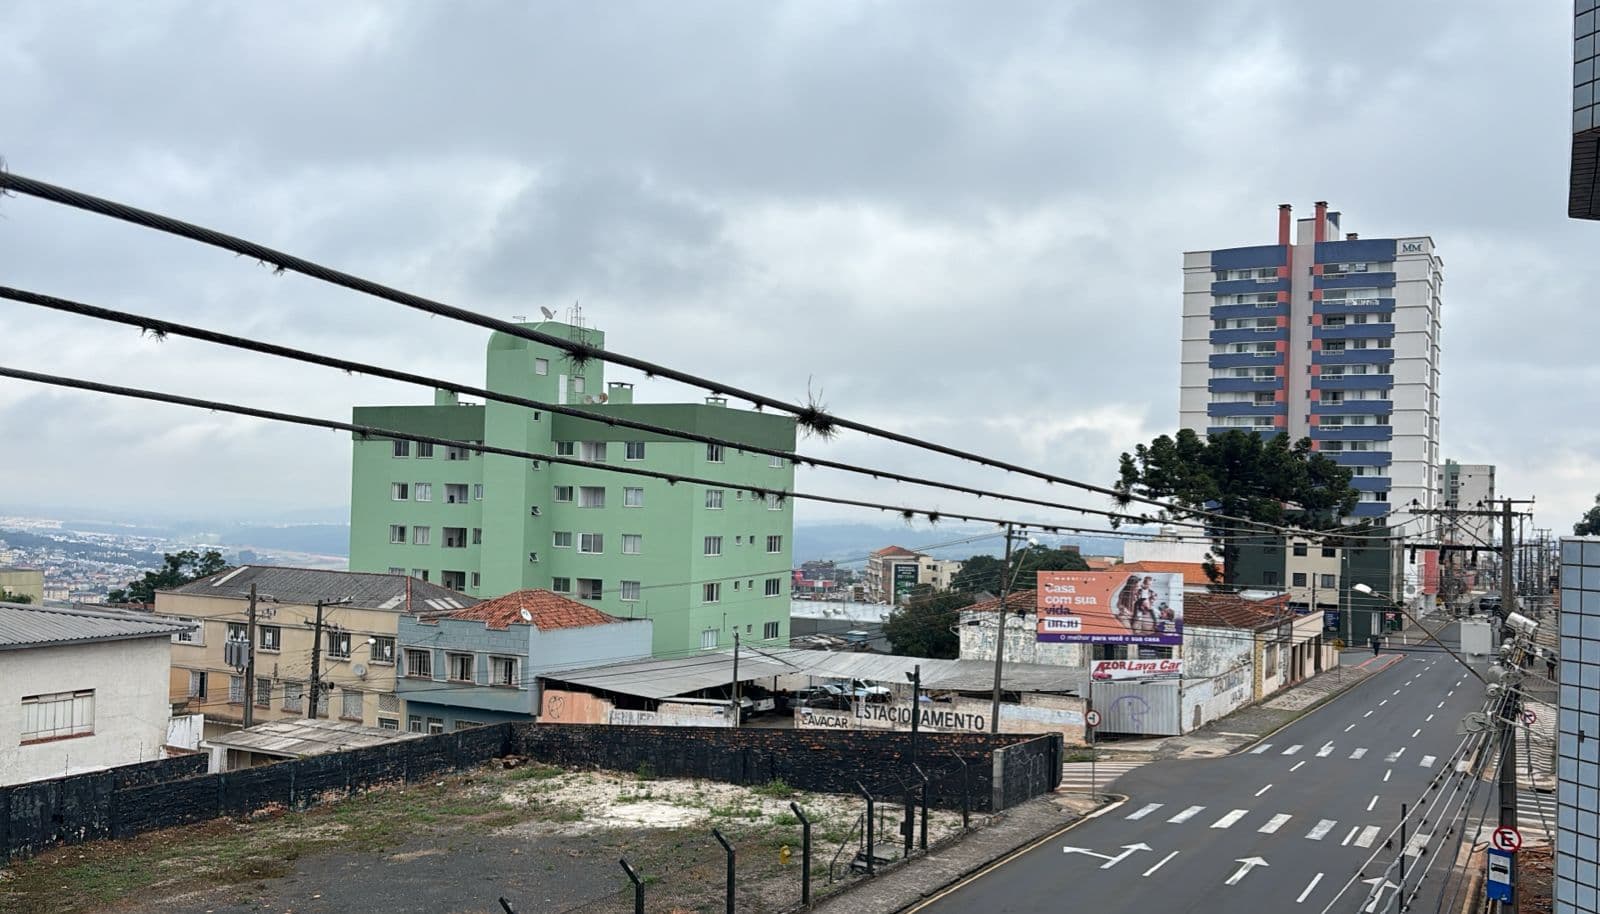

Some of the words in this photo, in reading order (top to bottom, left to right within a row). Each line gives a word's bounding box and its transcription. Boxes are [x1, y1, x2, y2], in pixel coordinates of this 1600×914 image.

[1045, 583, 1076, 593] Casa
[1045, 595, 1072, 604] com
[1074, 596, 1097, 605] sua
[1093, 661, 1126, 672] AZOR
[1127, 661, 1157, 671] Lava
[1159, 660, 1182, 671] Car
[855, 703, 985, 731] ESTACIOAMENTO
[1501, 831, 1513, 847] E
